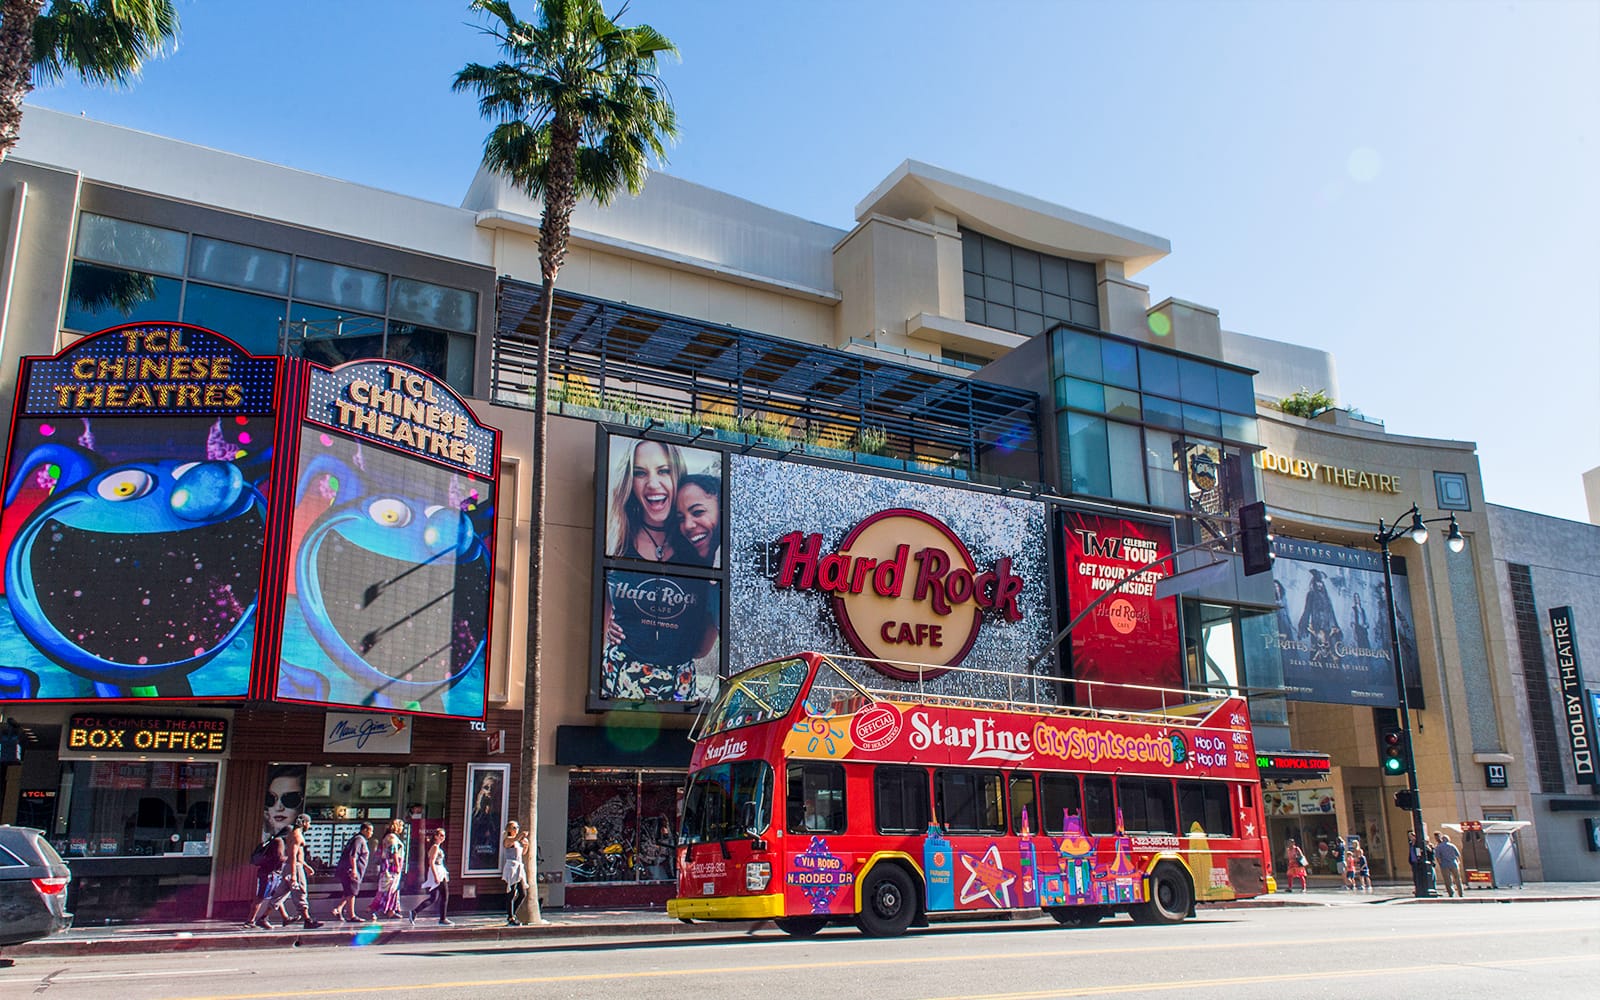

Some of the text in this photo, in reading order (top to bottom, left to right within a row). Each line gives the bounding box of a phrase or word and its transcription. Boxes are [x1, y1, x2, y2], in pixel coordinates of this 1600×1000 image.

[122, 330, 189, 352] TCL
[72, 357, 232, 380] CHINESE
[387, 365, 438, 404] TCL
[54, 384, 245, 408] THEATRES
[350, 379, 468, 439] CHINESE
[335, 399, 477, 466] THEATRES
[1267, 452, 1403, 493] DOLBY THEATRE
[1075, 528, 1124, 560] TMZ
[1123, 537, 1158, 550] CELEBRITY
[1272, 541, 1332, 559] THEATRES
[1337, 551, 1361, 562] MAY
[1123, 546, 1158, 564] TOUR
[776, 531, 1024, 622] Hard Rock
[1079, 562, 1097, 576] GET
[1098, 564, 1125, 580] YOUR
[881, 620, 943, 647] CAFE
[1553, 616, 1588, 748] DOLBY THEATRE
[73, 718, 225, 731] TCL CHINESE THEATRES
[470, 721, 487, 731] TCL
[858, 714, 893, 737] OFFICIAL
[69, 728, 224, 750] BOX OFFICE
[909, 711, 1034, 761] StarLine
[1195, 735, 1212, 750] Hop
[1214, 737, 1226, 750] On
[1197, 751, 1214, 767] Hop
[1216, 753, 1228, 767] Off
[1275, 758, 1309, 769] TROPICAL
[801, 857, 840, 869] VIA RODEO
[839, 873, 853, 884] DR
